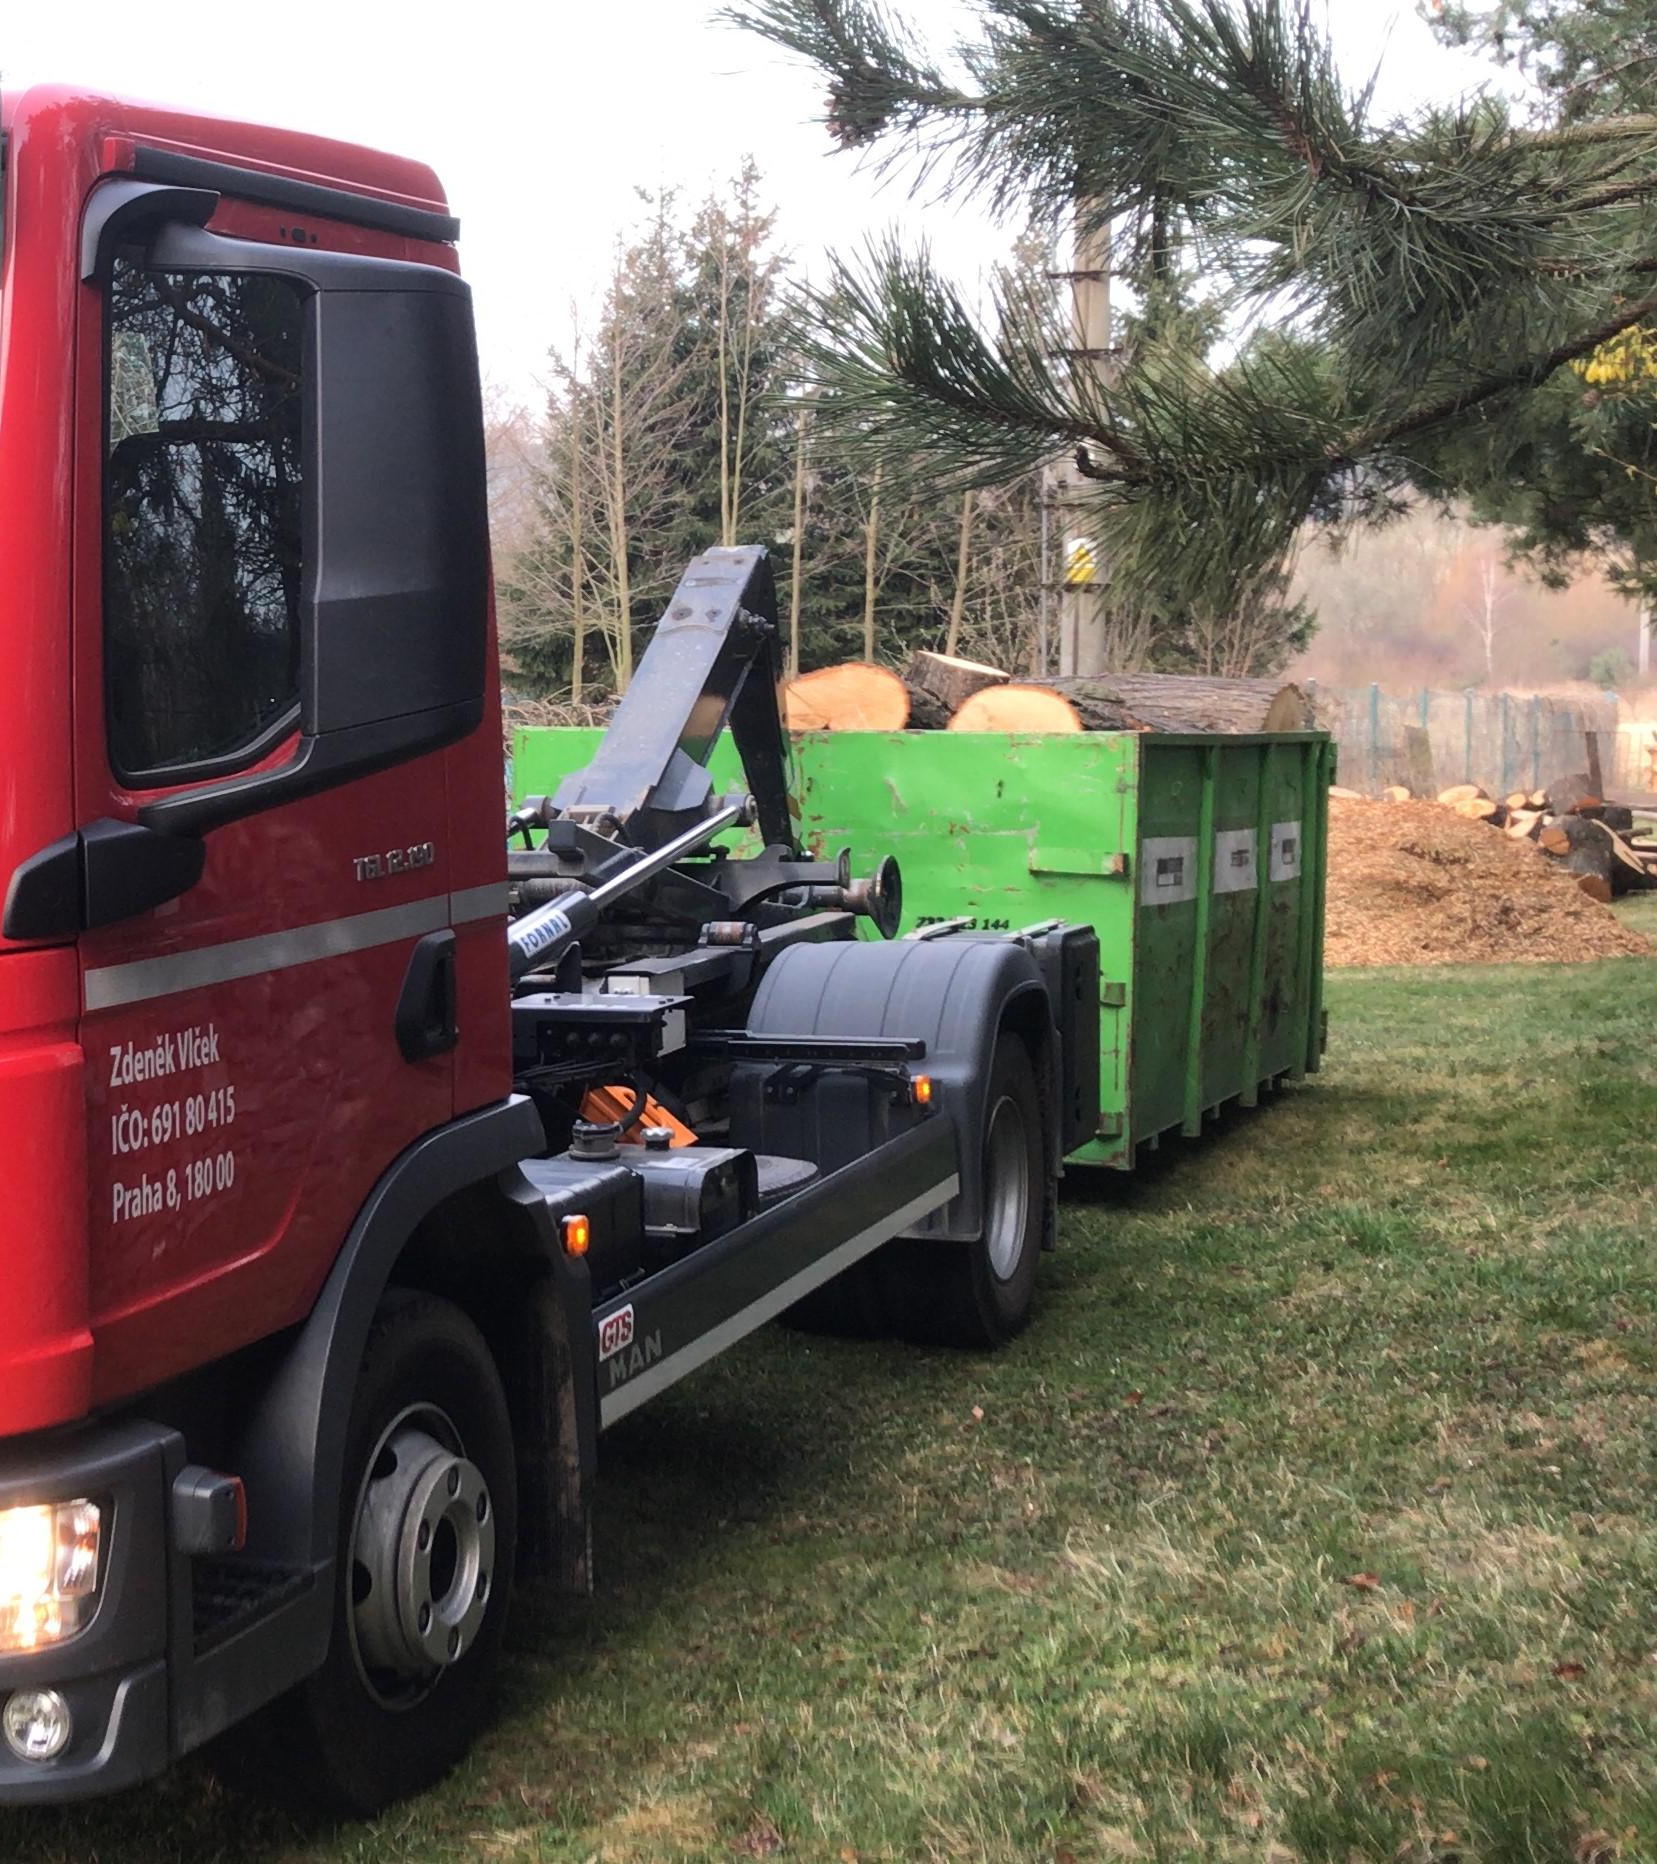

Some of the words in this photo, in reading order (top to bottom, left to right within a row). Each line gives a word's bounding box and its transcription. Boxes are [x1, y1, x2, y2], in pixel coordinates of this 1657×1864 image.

[520, 914, 569, 954] FORNAL
[981, 918, 1010, 930] 144
[109, 1033, 176, 1088] Zdeněk
[177, 1022, 220, 1071] Vlček
[111, 1103, 148, 1156] IČO:
[151, 1100, 181, 1145] 691
[185, 1093, 205, 1136] 80
[207, 1085, 236, 1128] 415
[112, 1173, 162, 1224] Praha
[166, 1168, 181, 1212] 8,
[185, 1156, 213, 1201] 180
[215, 1150, 235, 1191] 00
[601, 1309, 633, 1354] GTS
[608, 1327, 663, 1388] MAN
